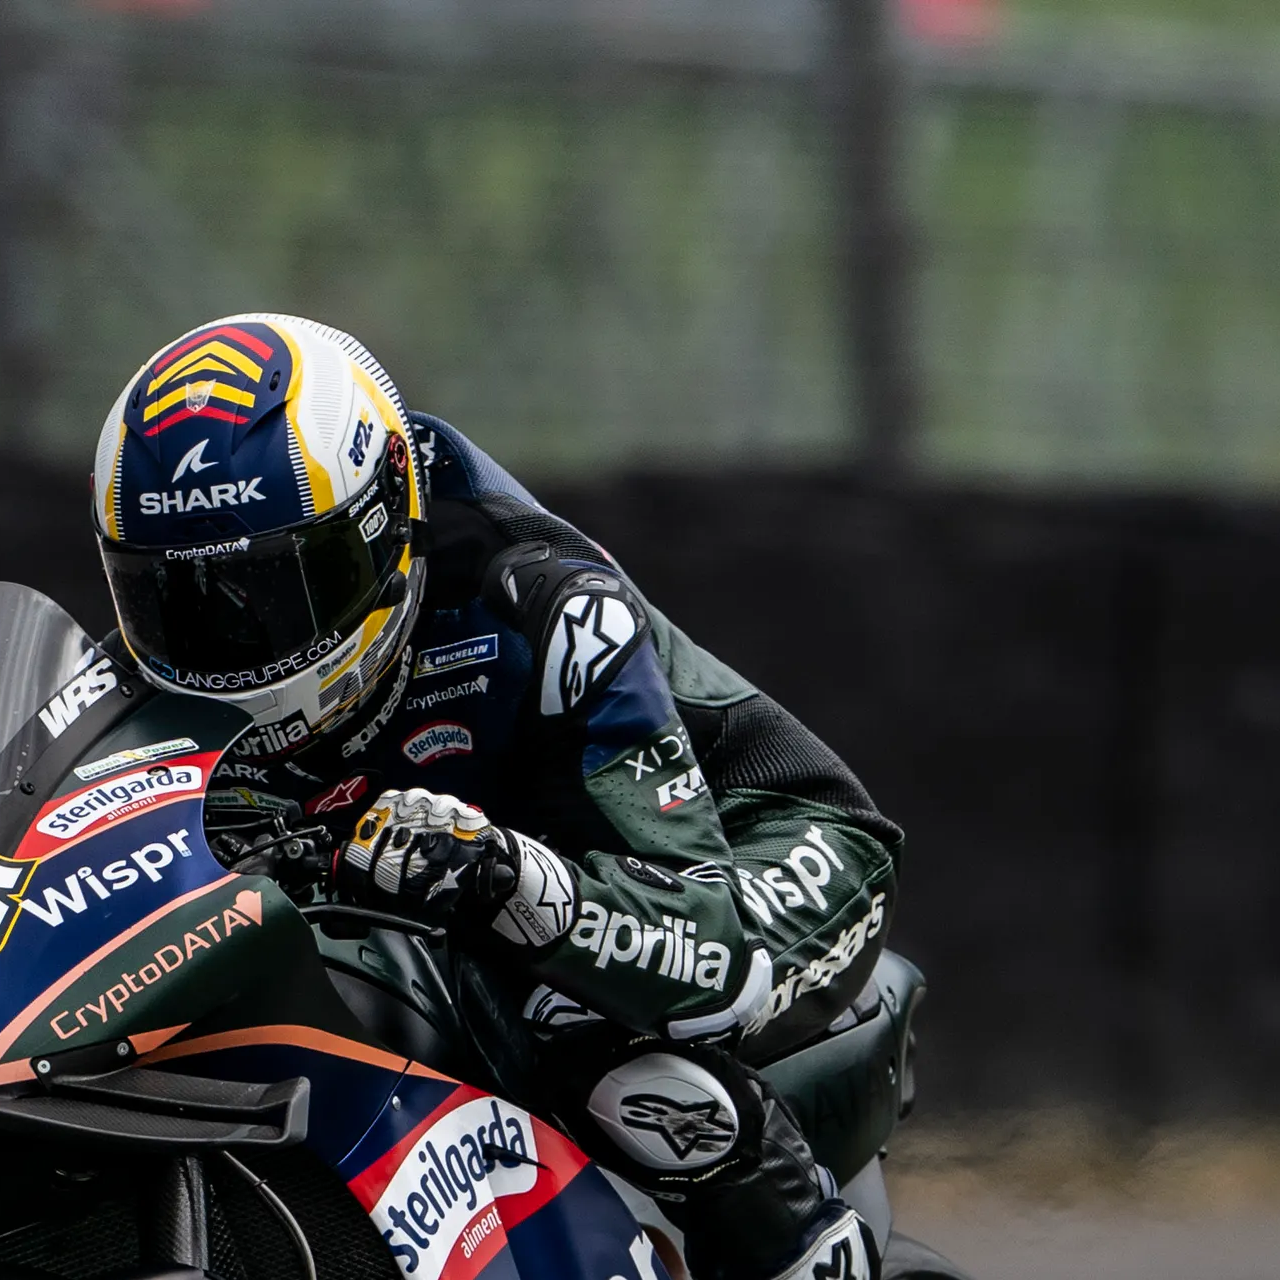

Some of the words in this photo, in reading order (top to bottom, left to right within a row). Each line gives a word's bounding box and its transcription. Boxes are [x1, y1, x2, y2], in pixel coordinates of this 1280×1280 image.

[139, 476, 267, 516] SHARK
[348, 480, 380, 517] SHARK
[364, 508, 385, 537] 100%
[165, 540, 243, 561] CryptoDATA
[174, 630, 343, 690] LANGGRUPPE.COM
[435, 643, 489, 666] MICHELIN
[38, 657, 118, 739] WRS
[405, 680, 481, 710] CryptoDATA
[408, 728, 470, 760] sterilgarda
[218, 763, 270, 784] ARK
[48, 767, 193, 834] sterilgarda
[106, 795, 158, 822] alimenti
[18, 827, 193, 928] Wispr
[570, 900, 731, 992] aprilia
[49, 908, 252, 1040] CryptoDATA
[382, 1100, 529, 1274] sterilgarda
